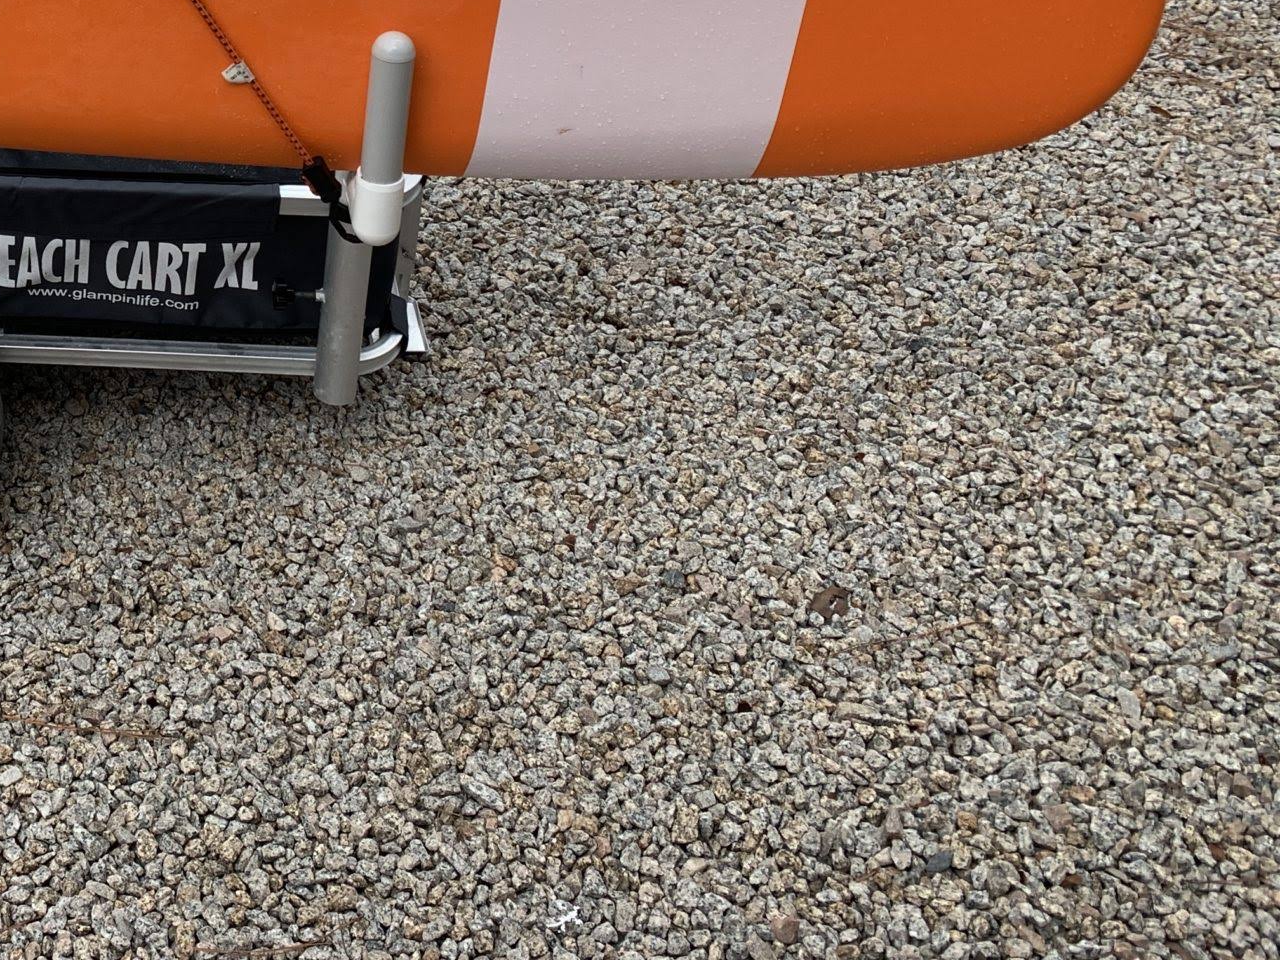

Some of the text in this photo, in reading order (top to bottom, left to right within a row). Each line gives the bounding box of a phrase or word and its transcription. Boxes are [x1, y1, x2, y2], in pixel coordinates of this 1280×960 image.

[105, 240, 207, 296] CART
[214, 242, 261, 291] XL
[28, 287, 199, 311] www.glampinlife.com
